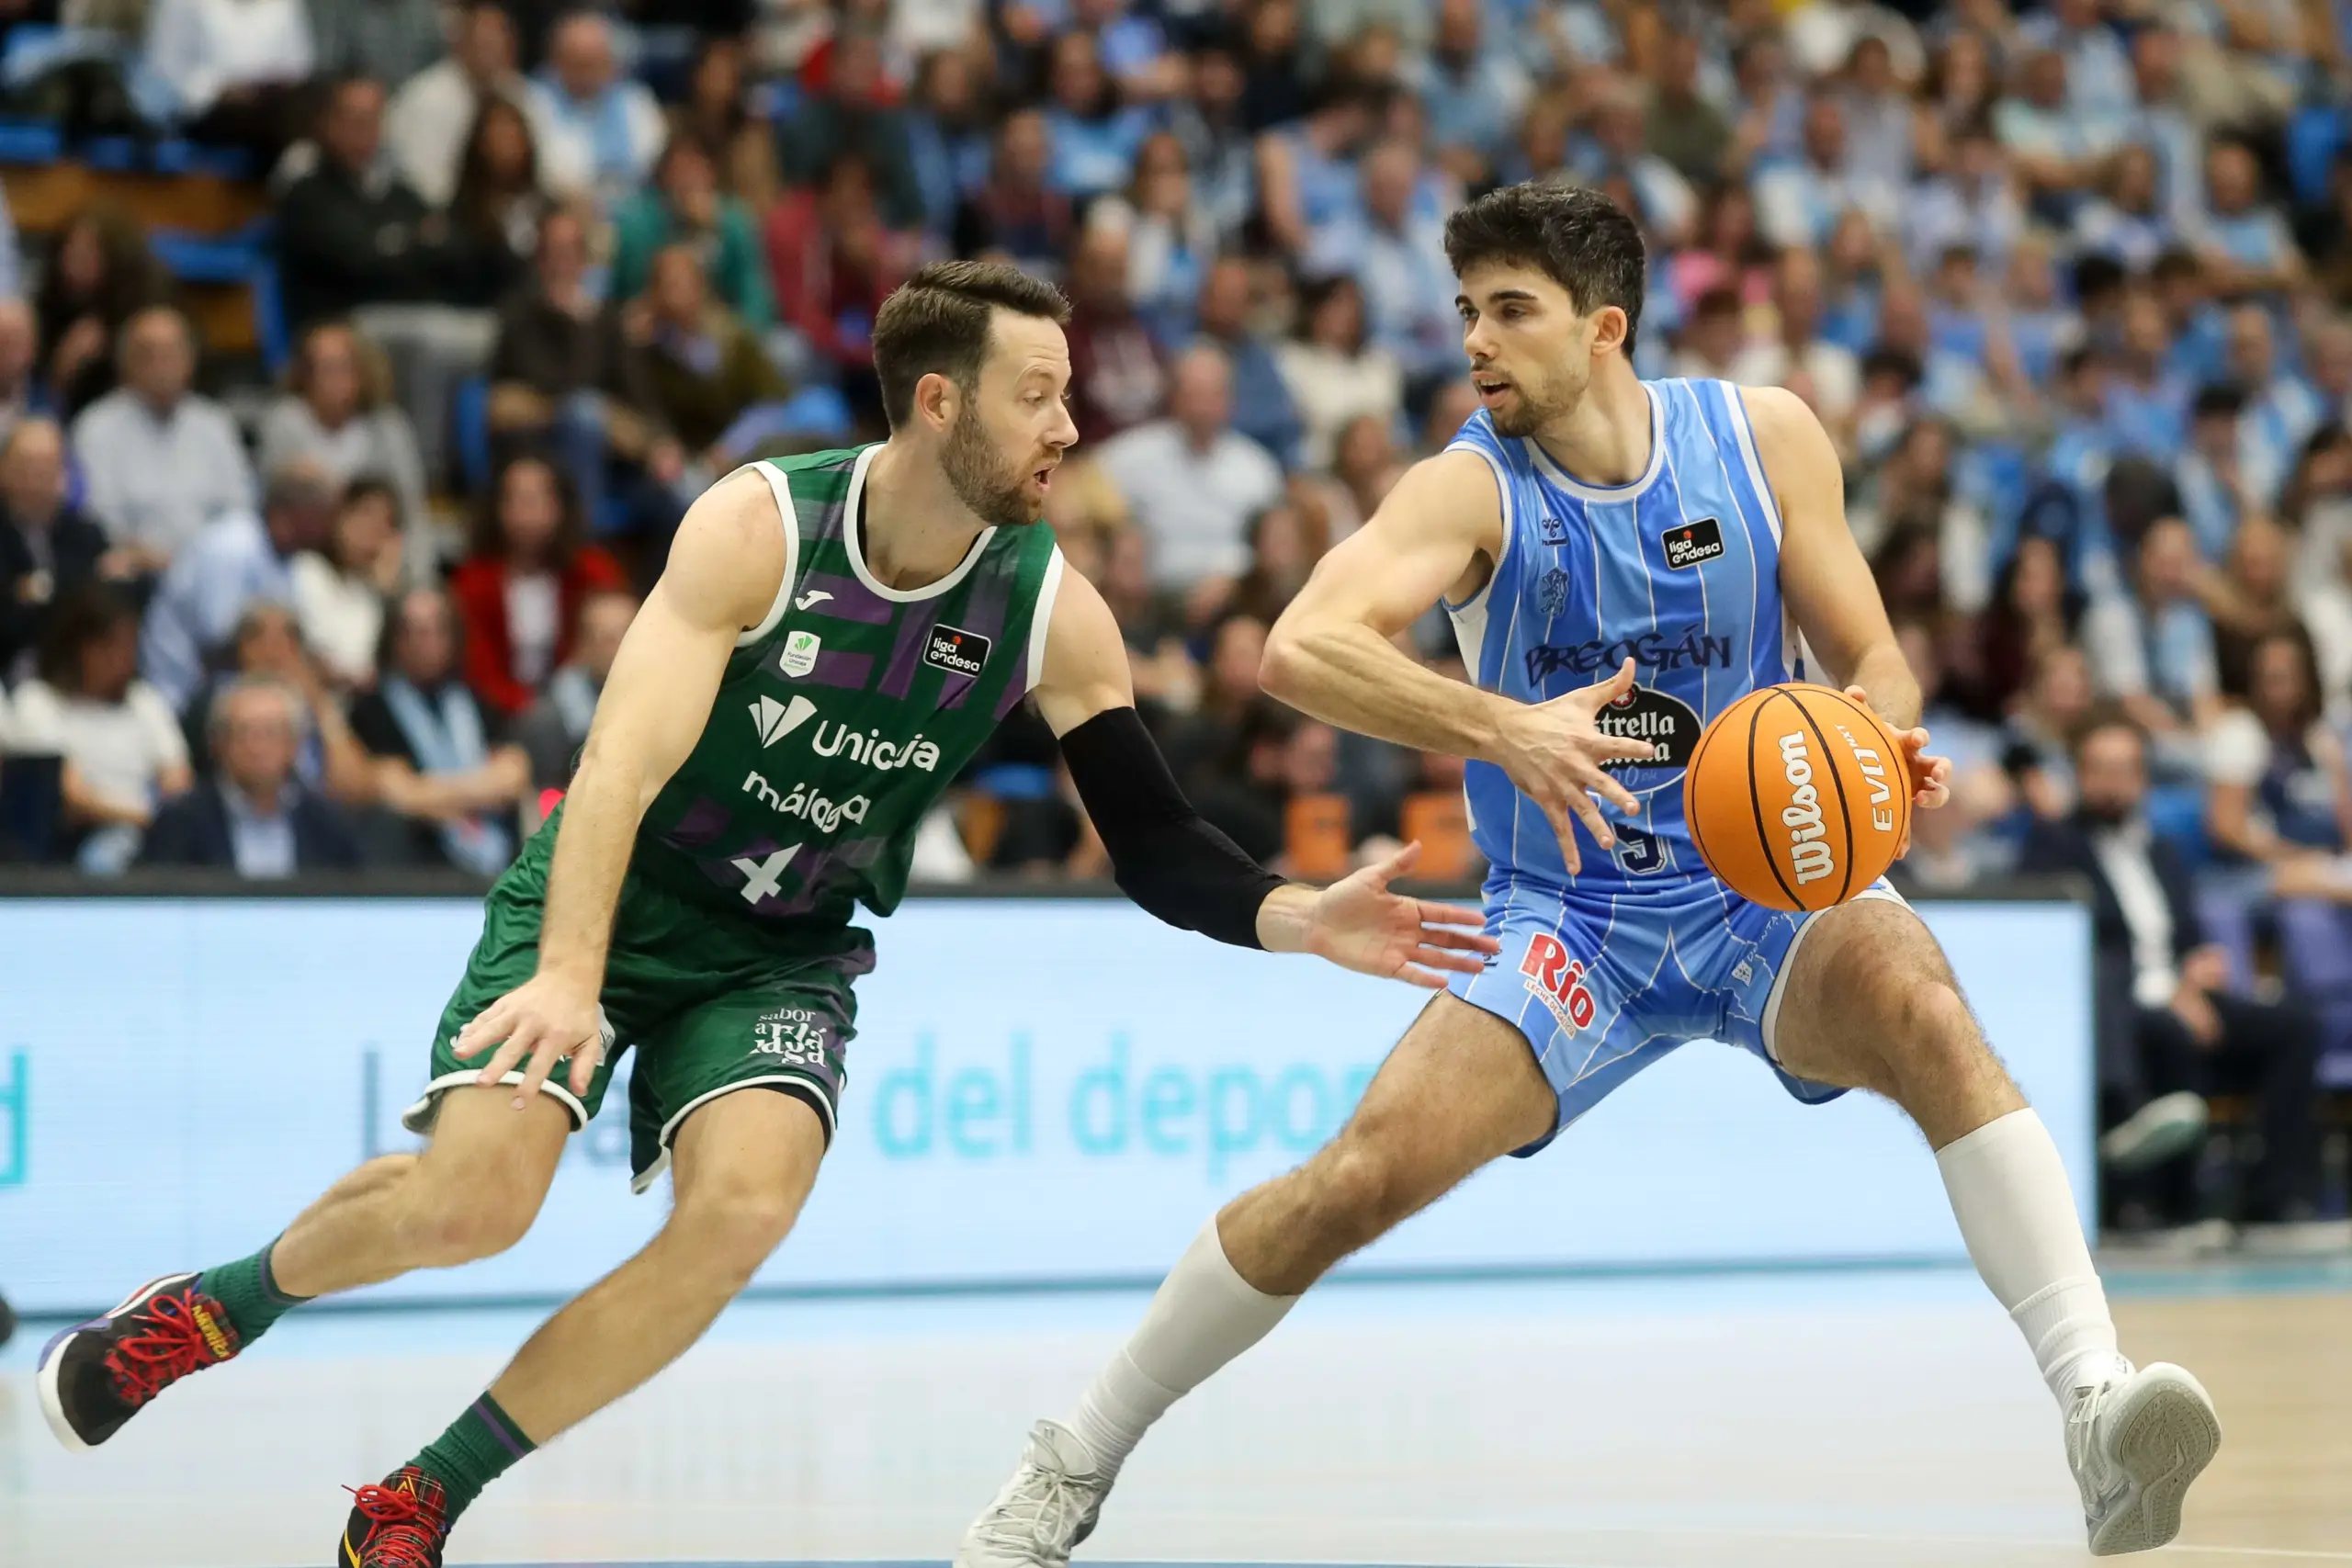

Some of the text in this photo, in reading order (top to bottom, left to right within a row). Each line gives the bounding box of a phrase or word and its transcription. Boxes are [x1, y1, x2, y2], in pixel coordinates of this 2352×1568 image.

[1668, 539, 1692, 553] liga
[1672, 542, 1720, 564] endesa
[933, 637, 957, 653] liga
[1525, 624, 1731, 689] BREOGÁN
[930, 650, 980, 671] endesa
[1595, 711, 1676, 737] trella
[812, 720, 941, 773] Unicja
[1852, 748, 1893, 831] EVO
[1778, 730, 1835, 885] Wilson
[1525, 980, 1549, 1004] LECHE
[758, 1007, 817, 1022] sabor
[871, 1028, 1381, 1185] del depor
